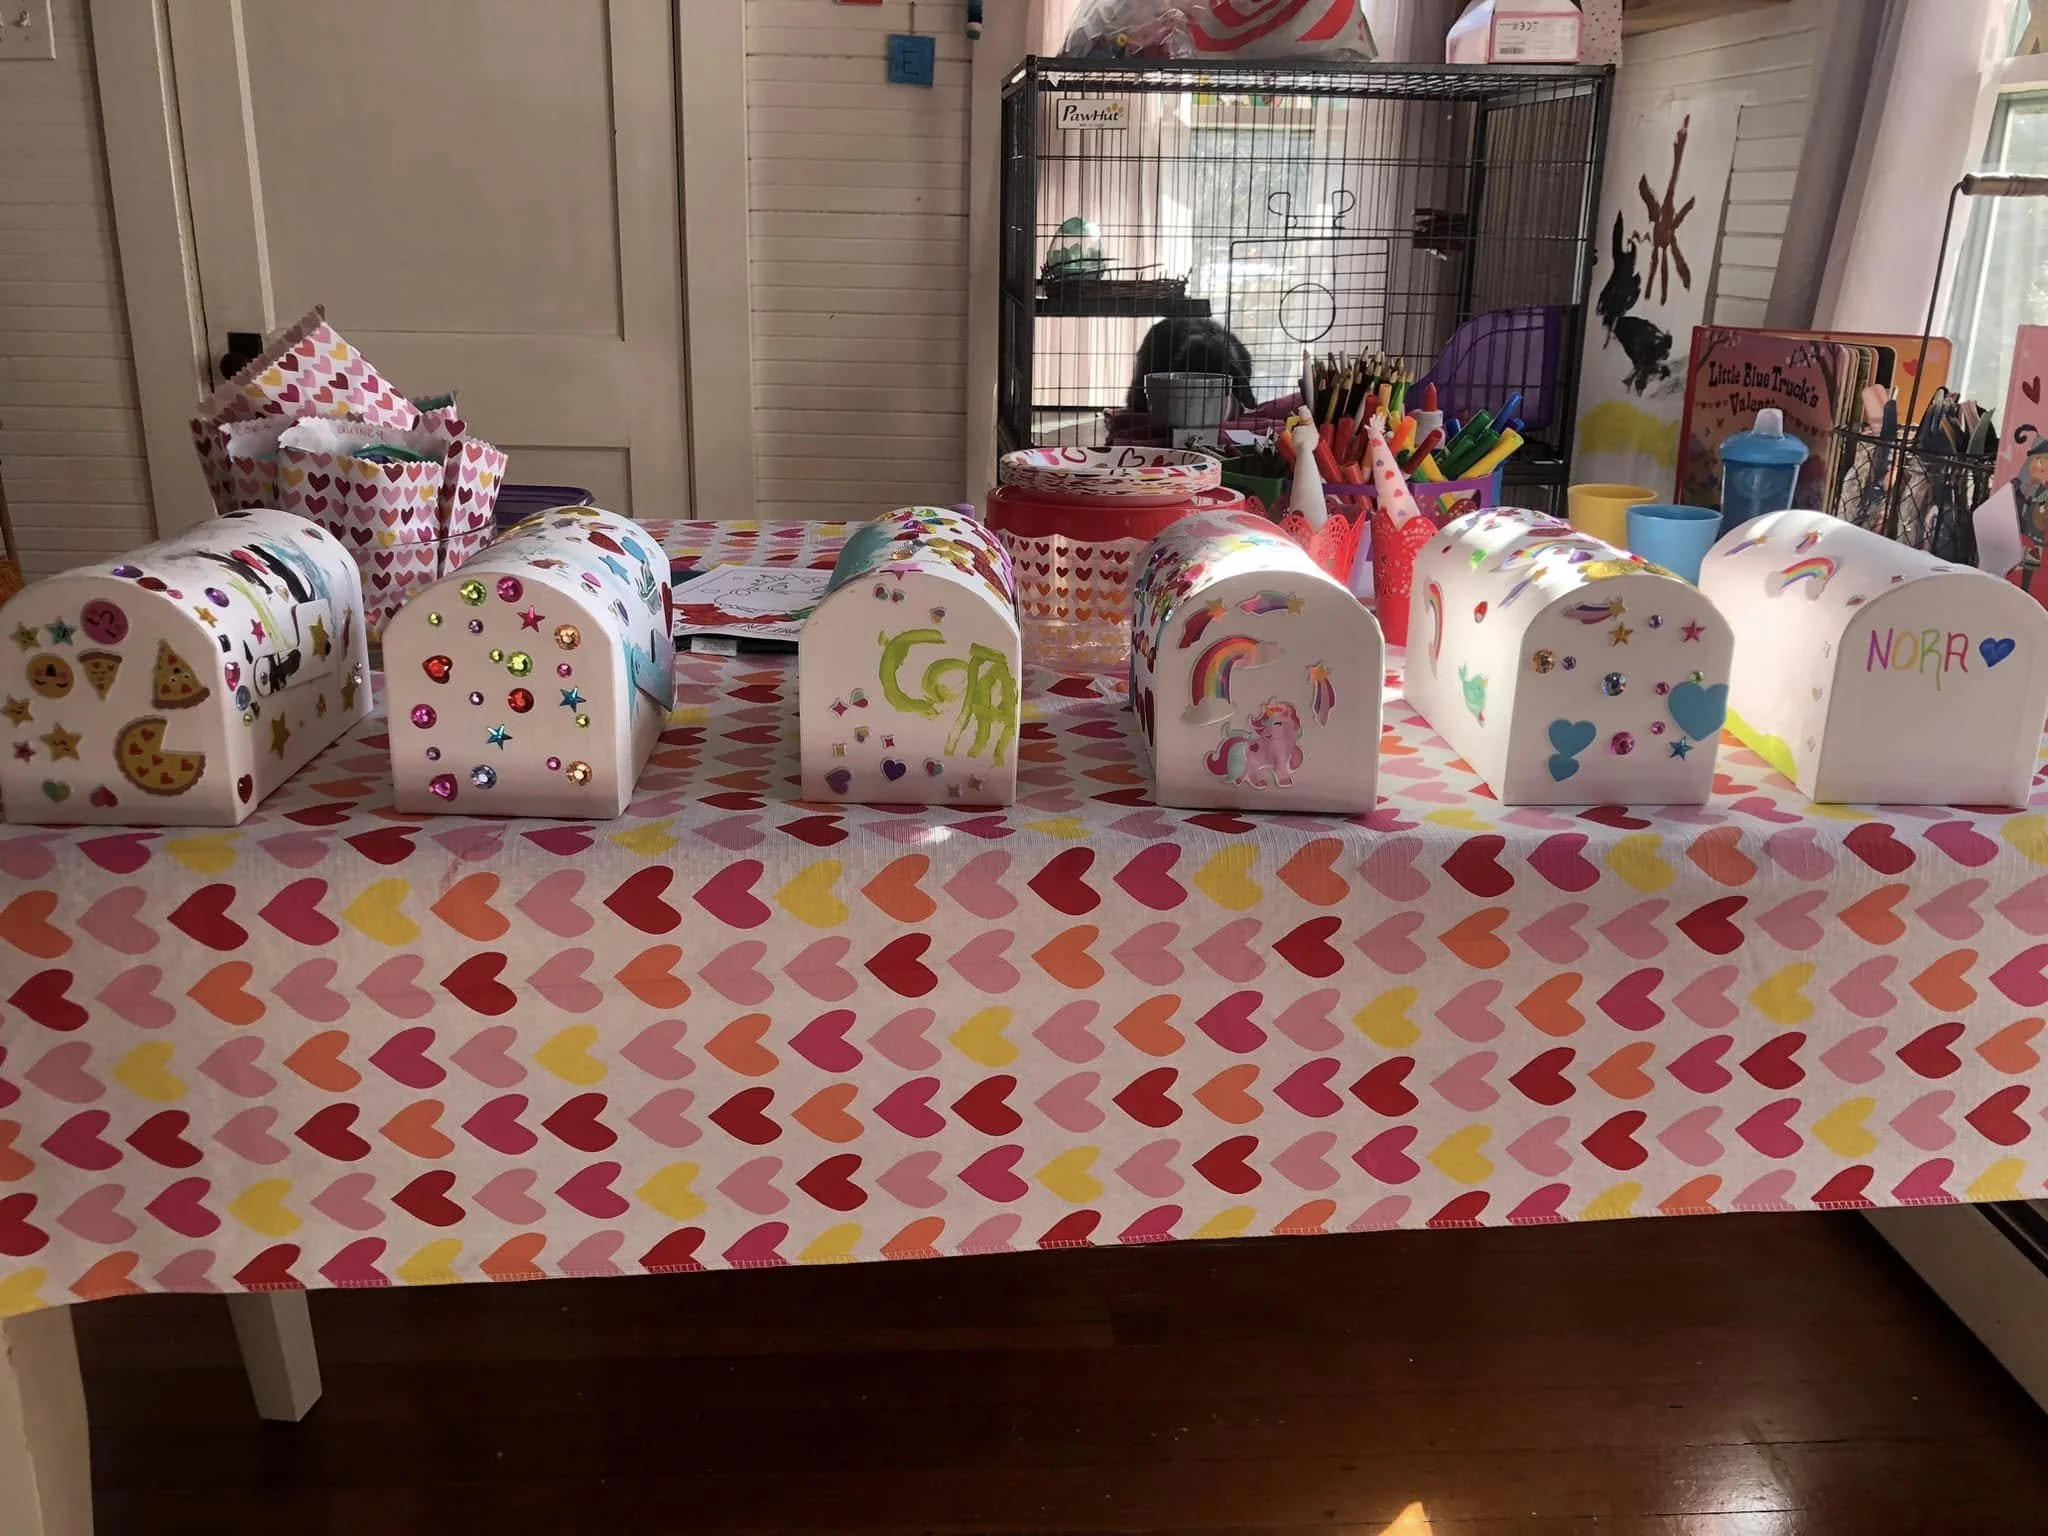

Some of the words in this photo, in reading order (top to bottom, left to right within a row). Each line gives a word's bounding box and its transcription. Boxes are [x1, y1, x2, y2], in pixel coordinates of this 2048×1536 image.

[903, 50, 919, 75] E
[1062, 104, 1120, 121] PawHut
[1708, 361, 1740, 387] Little
[1743, 362, 1770, 389] Blue
[1771, 365, 1819, 408] Truck's
[1729, 391, 1787, 416] Valenti
[1866, 627, 1969, 691] NORA
